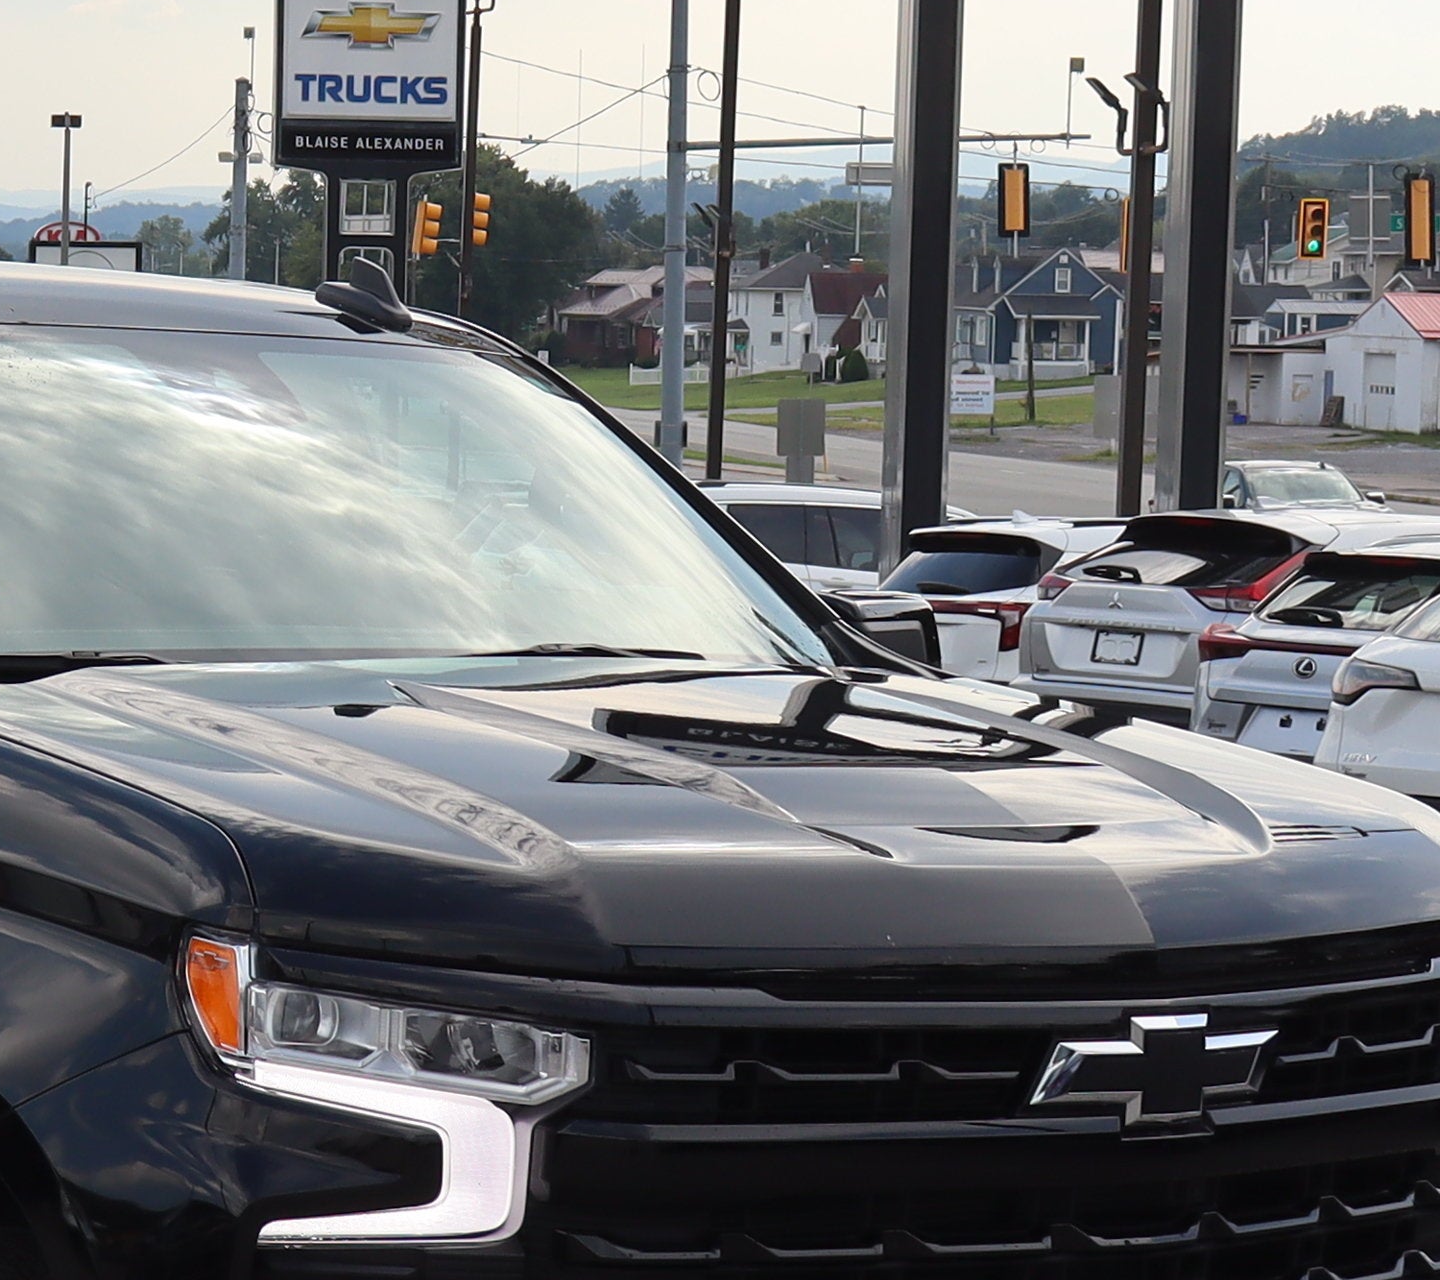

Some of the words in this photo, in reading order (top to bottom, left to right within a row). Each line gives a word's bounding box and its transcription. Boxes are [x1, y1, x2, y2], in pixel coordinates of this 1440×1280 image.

[294, 73, 448, 105] TRUCKS
[295, 135, 348, 149] BLAISE
[356, 137, 444, 151] ALEXANDER
[46, 229, 88, 241] KA
